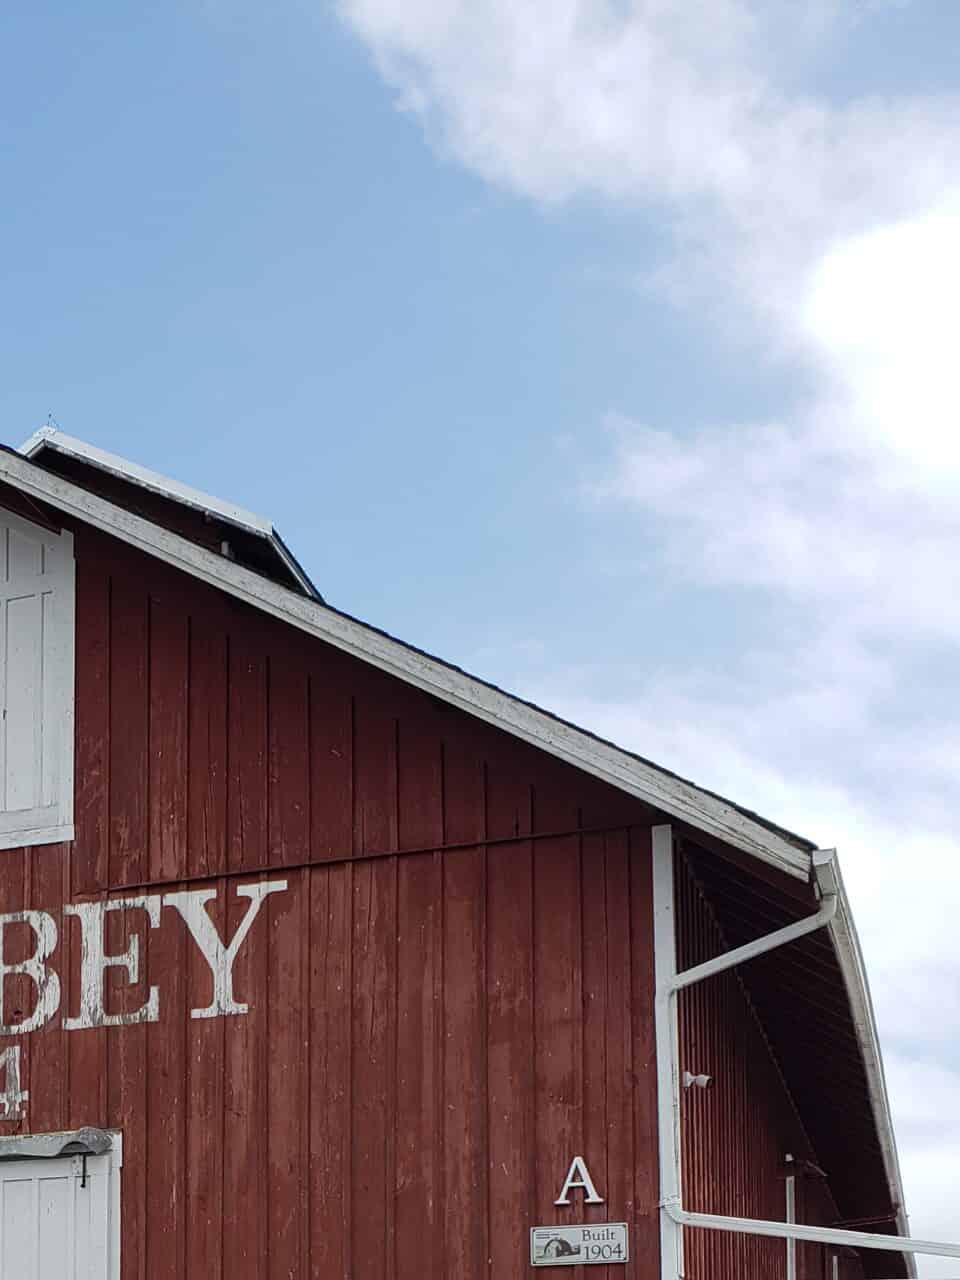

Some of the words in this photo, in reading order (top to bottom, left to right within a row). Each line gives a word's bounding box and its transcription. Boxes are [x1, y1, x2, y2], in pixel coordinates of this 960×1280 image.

[553, 1156, 605, 1205] A
[582, 1228, 616, 1241] Built
[583, 1243, 623, 1260] 1904
